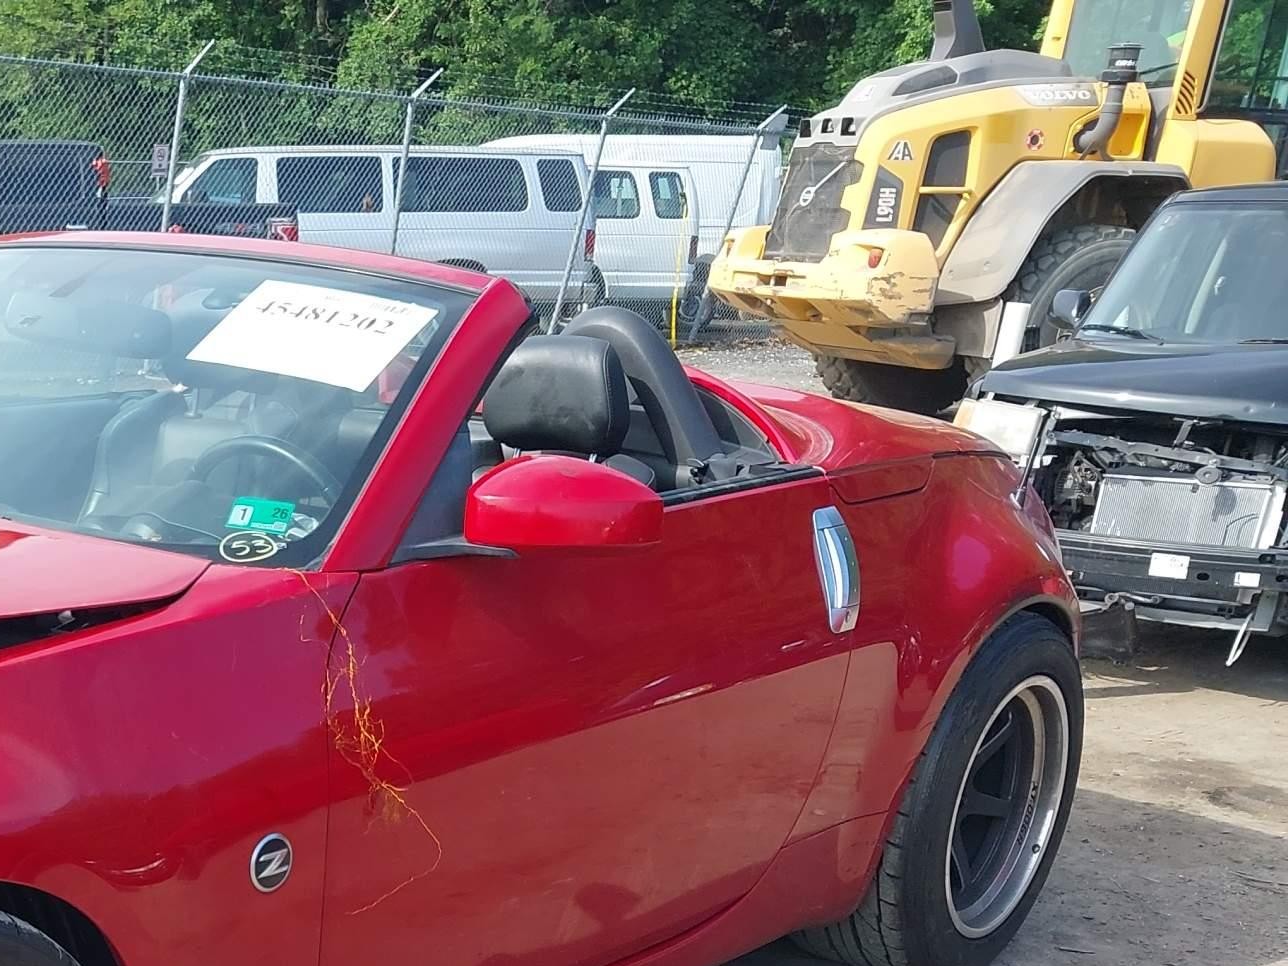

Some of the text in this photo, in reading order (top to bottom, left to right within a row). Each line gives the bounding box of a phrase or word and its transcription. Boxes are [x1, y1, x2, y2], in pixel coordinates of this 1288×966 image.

[875, 187, 897, 222] L90H
[256, 300, 395, 334] 45481202
[240, 507, 248, 520] 1
[273, 507, 289, 519] 26
[231, 540, 272, 555] 53
